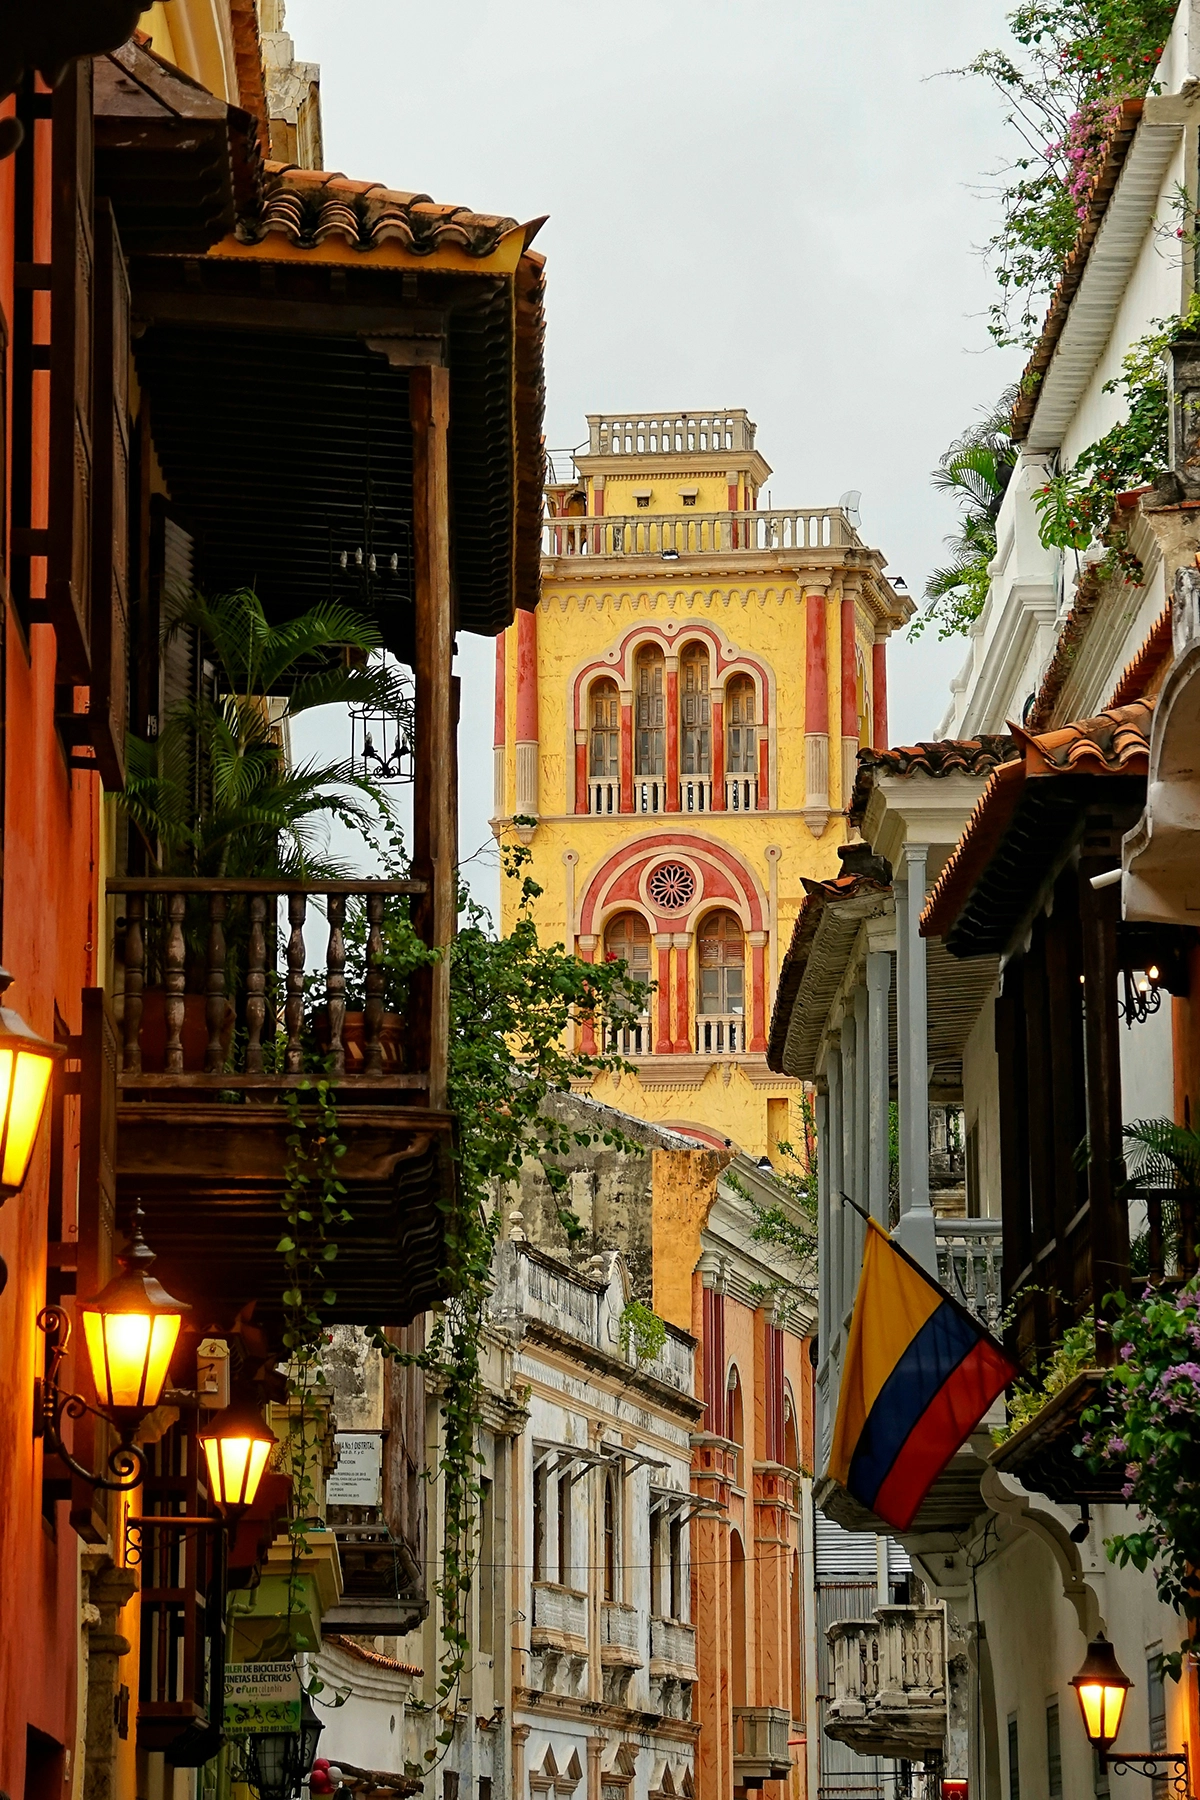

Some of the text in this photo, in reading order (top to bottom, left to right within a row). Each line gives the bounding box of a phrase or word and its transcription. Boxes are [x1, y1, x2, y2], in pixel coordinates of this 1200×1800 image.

[354, 1442, 375, 1450] DISTRITAL
[243, 1665, 252, 1673] DE
[253, 1664, 291, 1673] BICICLETAS
[252, 1673, 291, 1682] ELÉCTRICAS
